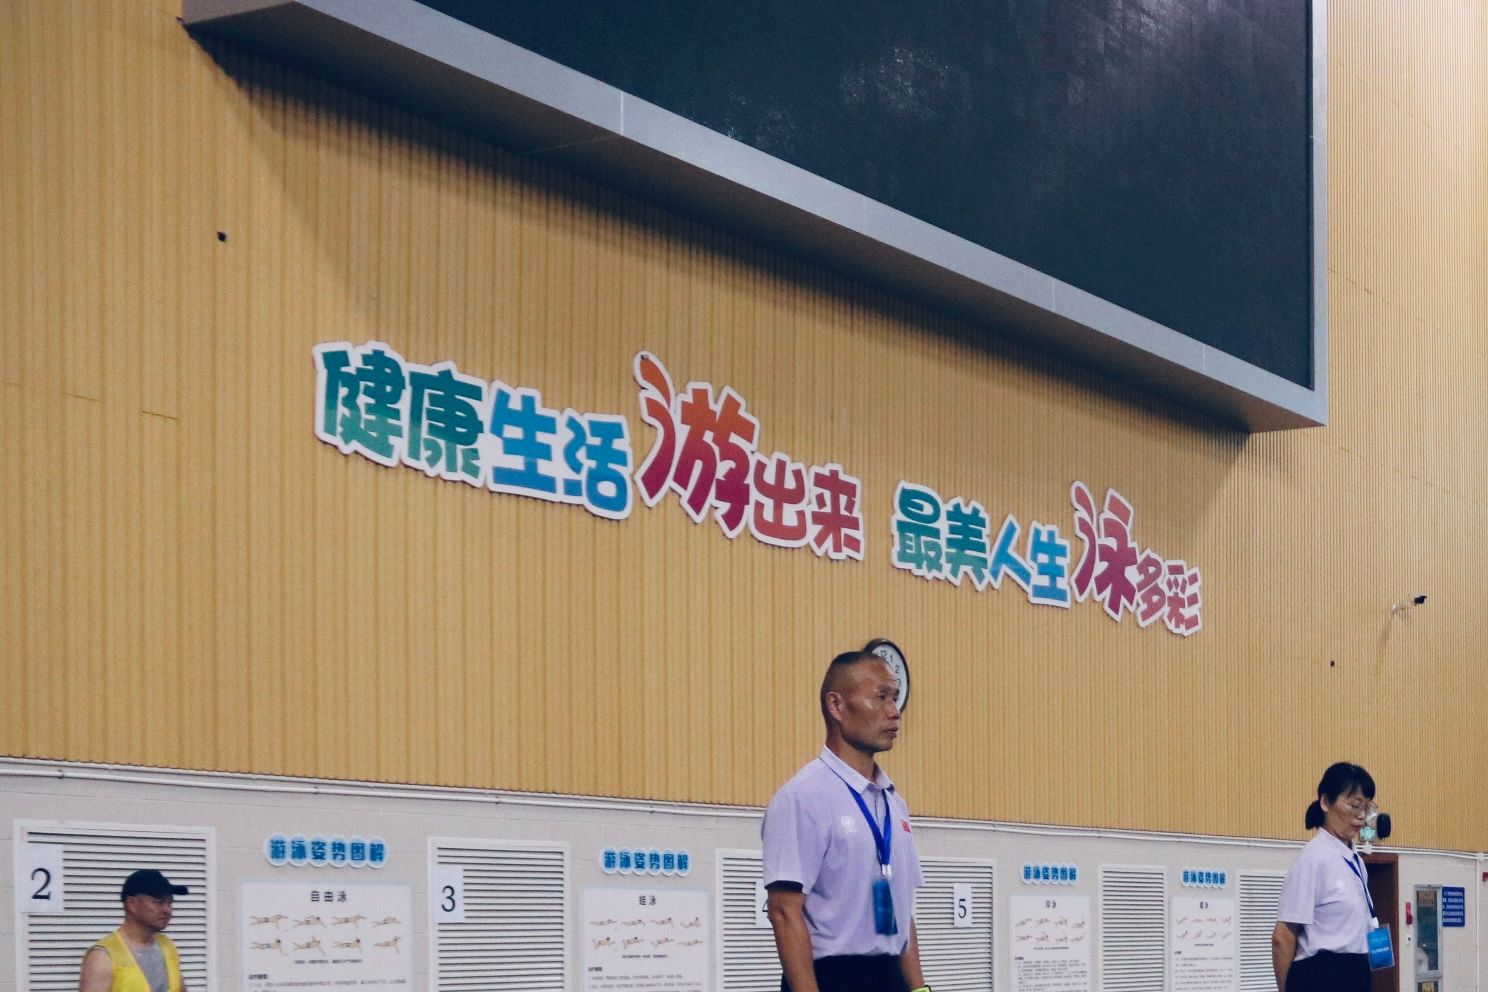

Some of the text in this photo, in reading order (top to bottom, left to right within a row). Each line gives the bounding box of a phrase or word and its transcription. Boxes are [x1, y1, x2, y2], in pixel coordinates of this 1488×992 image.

[318, 347, 1201, 635] 健康生活游出来 最美人生泳多彩
[270, 839, 385, 861] 游泳姿势图解
[604, 851, 689, 870] 游泳姿势图解
[31, 867, 51, 900] 2
[311, 891, 347, 902] 自由泳
[441, 885, 456, 912] 3
[958, 898, 967, 919] 5
